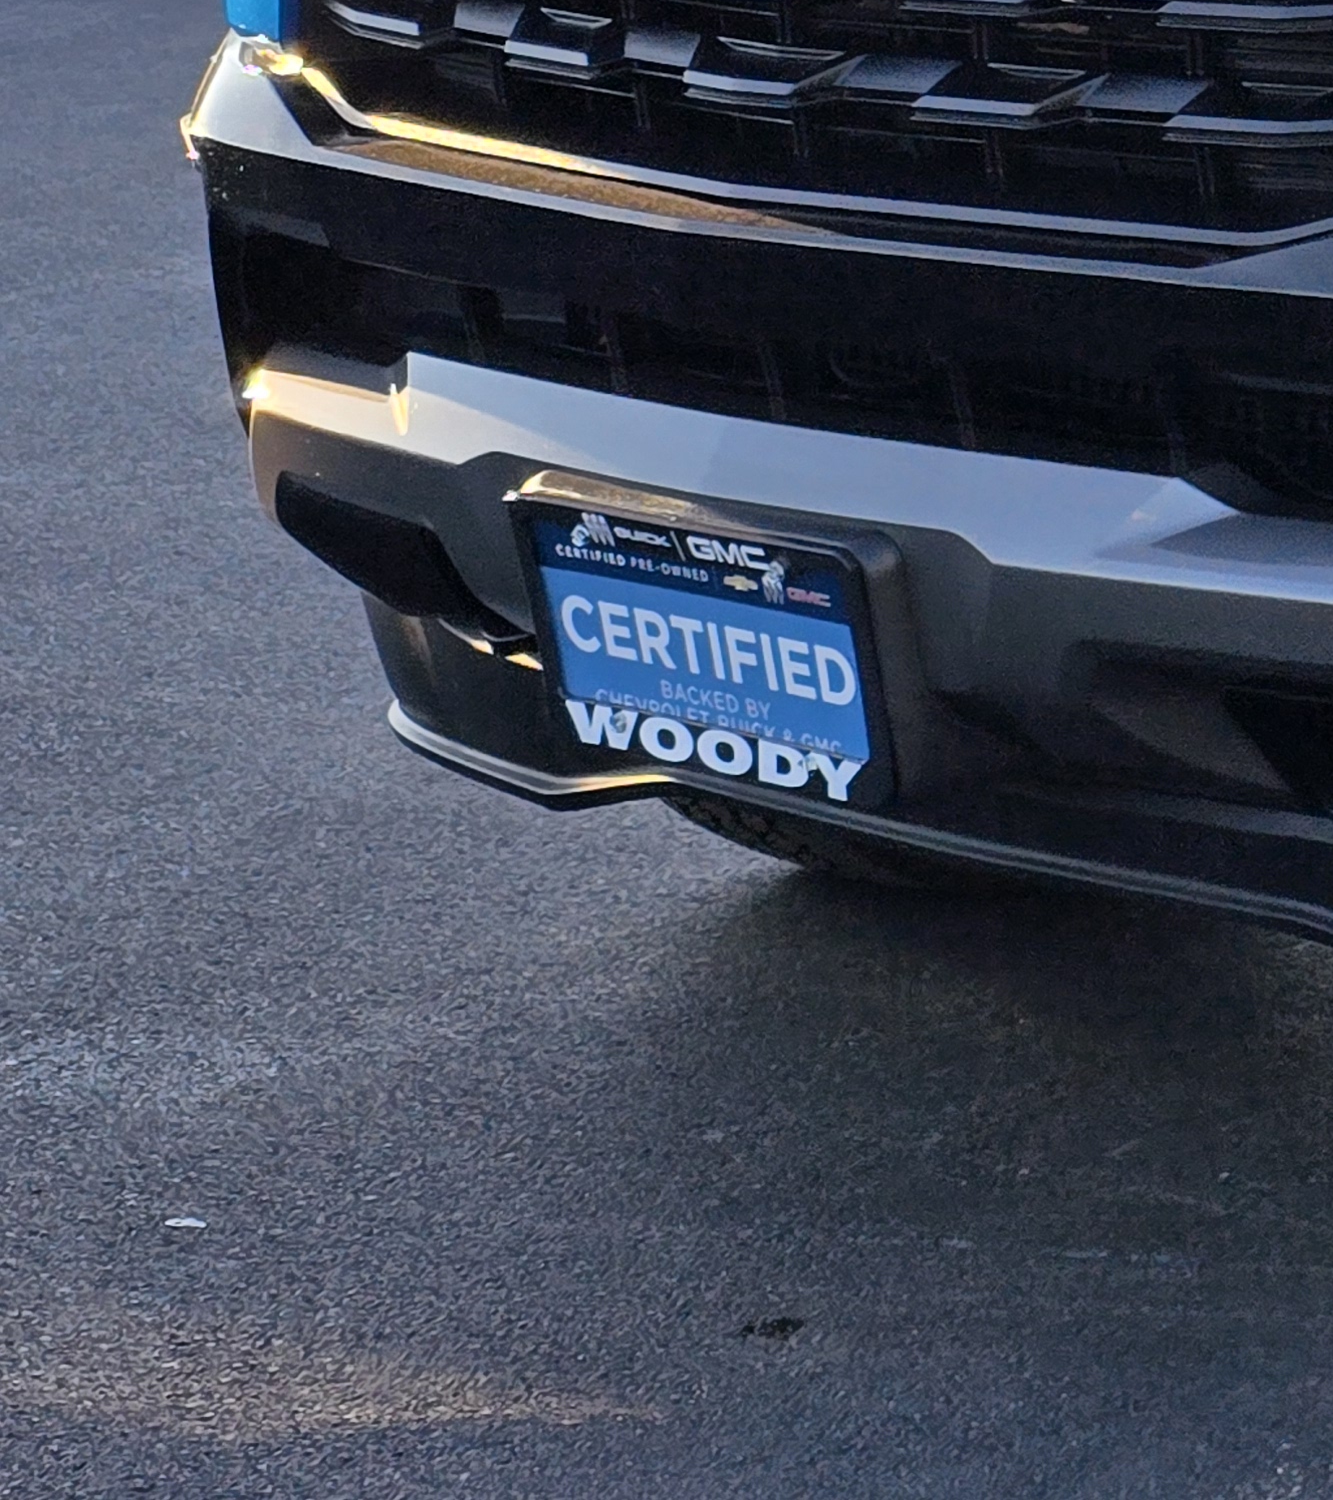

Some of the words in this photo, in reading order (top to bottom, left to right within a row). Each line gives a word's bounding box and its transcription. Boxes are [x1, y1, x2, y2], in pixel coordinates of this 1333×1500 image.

[555, 543, 626, 567] CERTIFIED
[630, 556, 709, 582] PRE-OWNED
[613, 526, 672, 548] BUICK
[686, 535, 771, 571] GMC
[560, 594, 857, 706] CERTIFIED
[660, 679, 740, 713] BACKED
[744, 697, 771, 720] BY
[565, 699, 863, 801] WOODY
